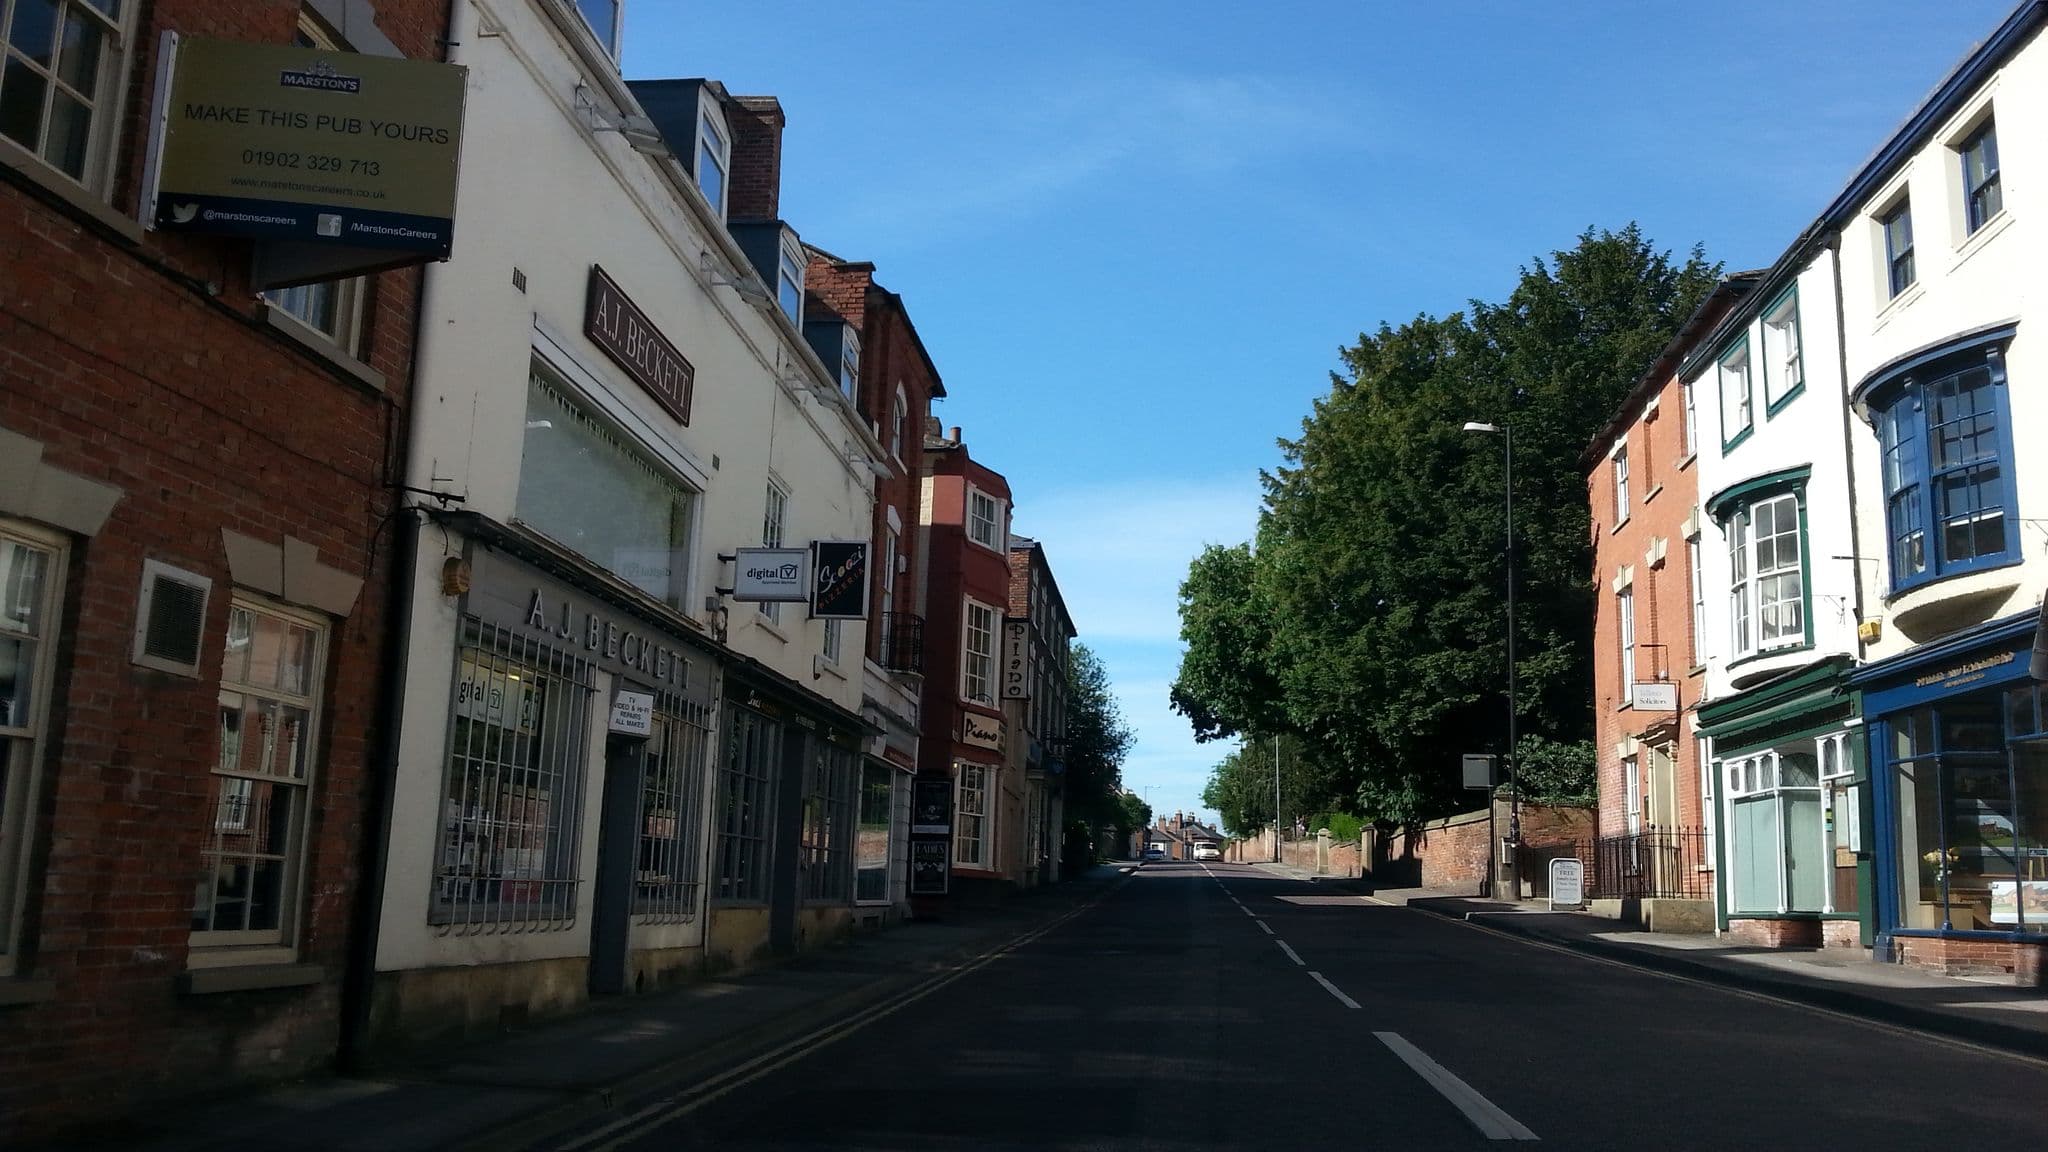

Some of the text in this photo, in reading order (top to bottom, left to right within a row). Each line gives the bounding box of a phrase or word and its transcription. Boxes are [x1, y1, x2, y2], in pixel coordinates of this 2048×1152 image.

[284, 72, 358, 91] MARSTON'S
[184, 103, 449, 145] MAKE THIS PUB YOURS
[242, 149, 380, 177] 01902 329 713
[230, 176, 386, 200] www.marstonscareers.co.uk
[203, 208, 437, 241] @marstonscareers /MarstonsCareers
[626, 316, 689, 408] BECKETT
[747, 568, 778, 581] digital
[587, 614, 693, 690] BECKETT
[620, 710, 642, 720] REPAIRS
[626, 719, 645, 729] MAKES
[965, 718, 998, 742] Piano
